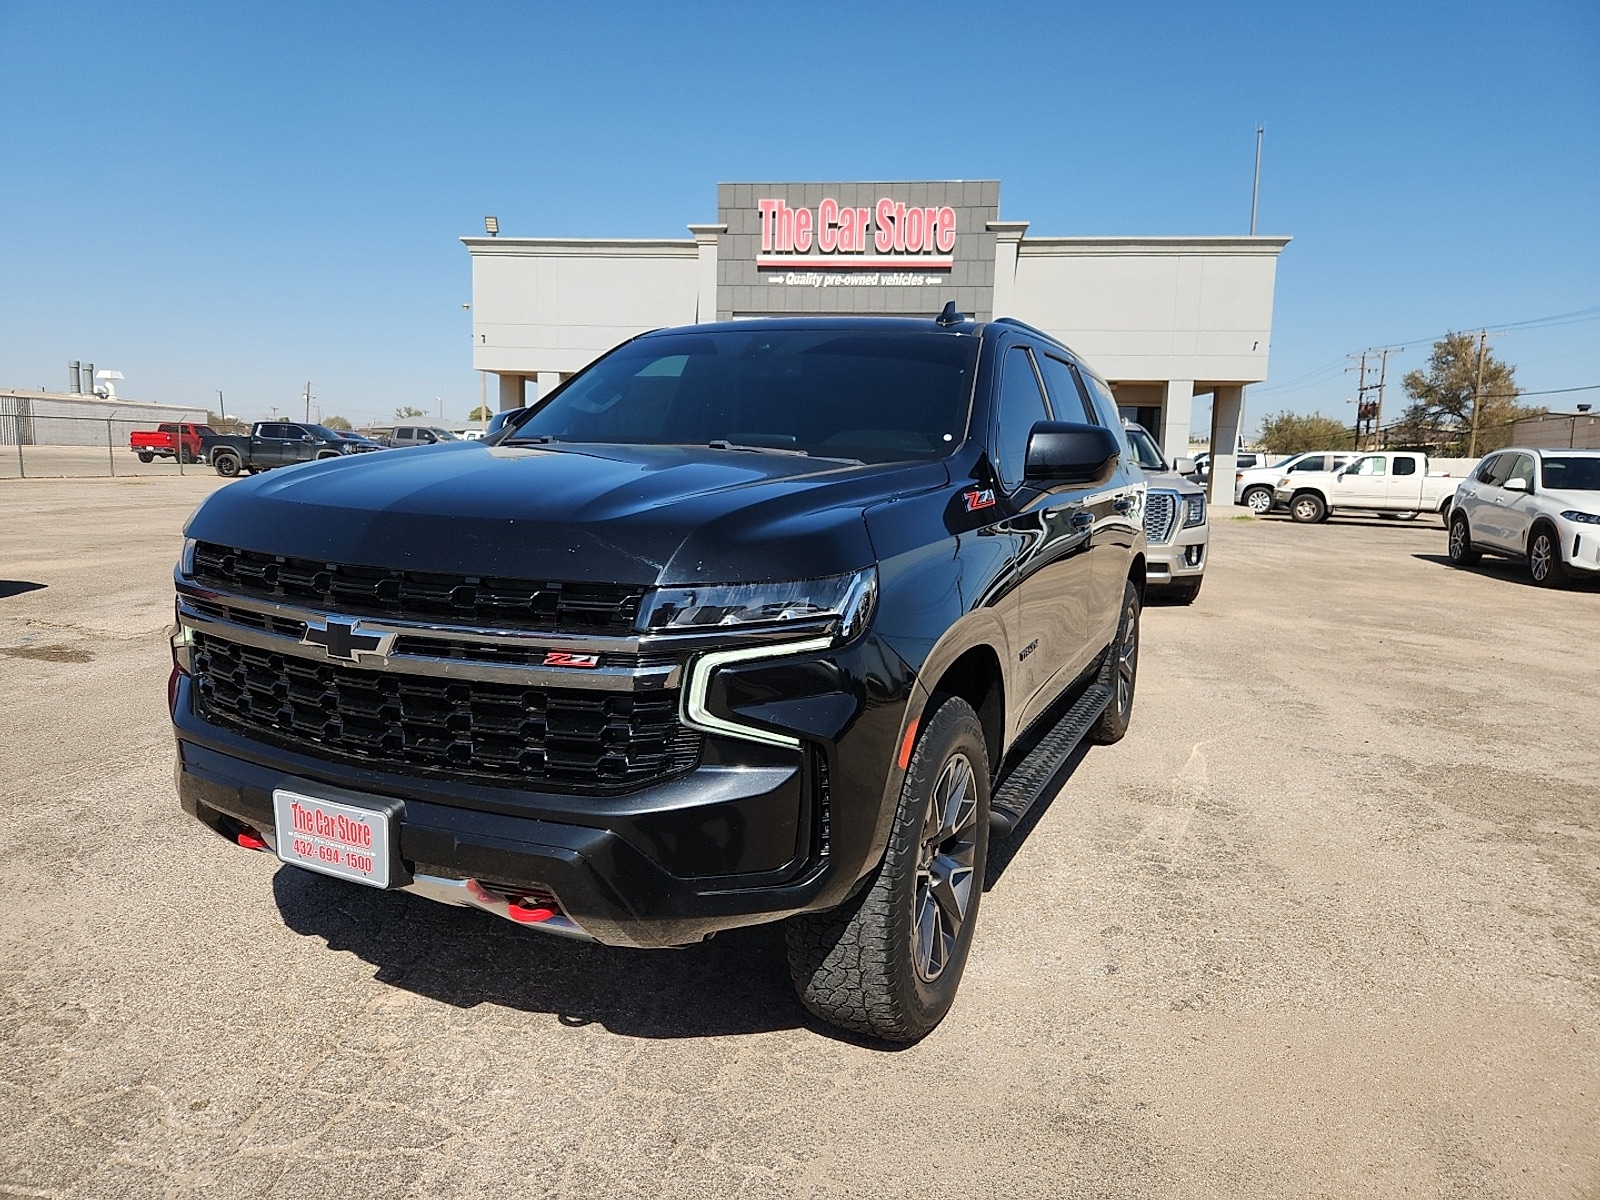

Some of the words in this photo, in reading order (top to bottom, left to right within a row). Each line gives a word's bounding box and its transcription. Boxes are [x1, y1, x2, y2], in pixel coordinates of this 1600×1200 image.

[758, 198, 813, 252] The
[818, 198, 870, 252] Car
[875, 197, 956, 252] Store
[785, 272, 823, 287] Quality
[824, 274, 879, 287] pre-owned
[880, 272, 924, 286] vehicles
[291, 803, 314, 832] The
[314, 808, 337, 838] Car
[337, 814, 372, 849] Store
